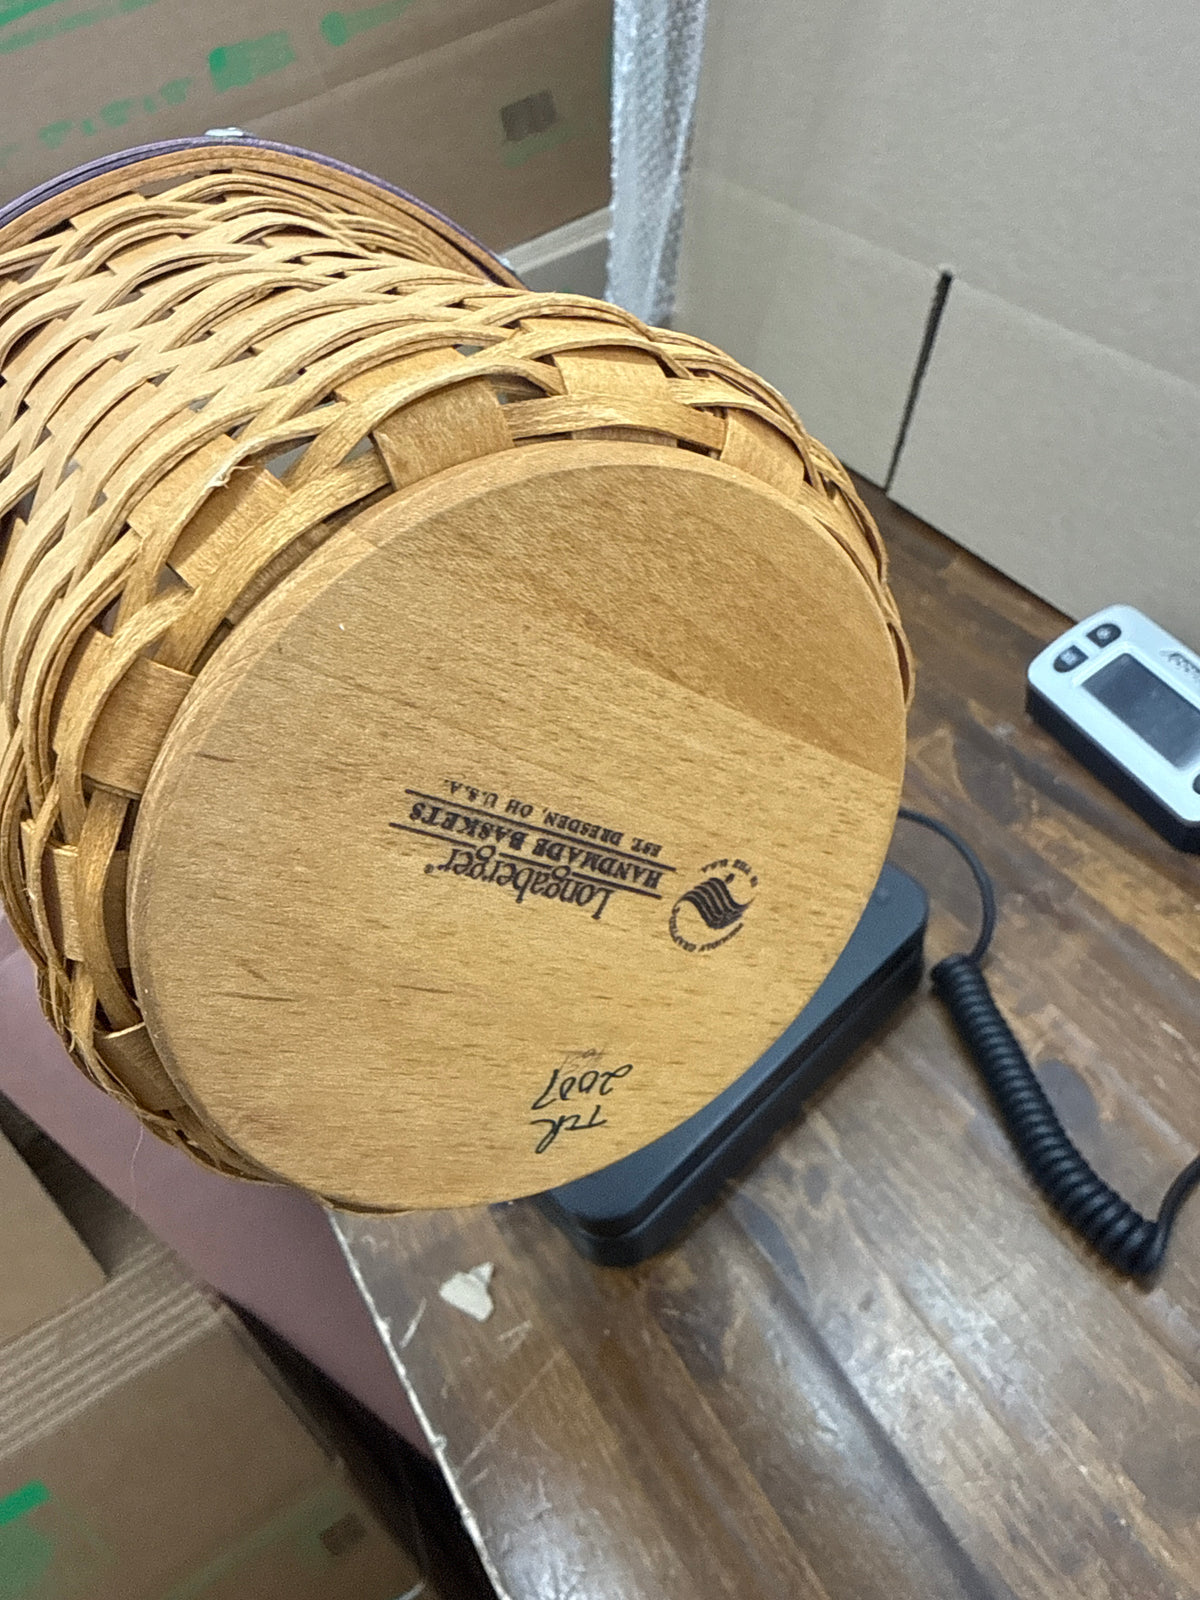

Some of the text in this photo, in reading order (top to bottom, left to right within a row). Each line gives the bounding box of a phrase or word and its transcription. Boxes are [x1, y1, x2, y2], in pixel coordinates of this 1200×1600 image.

[507, 799, 533, 818] OH
[543, 808, 624, 845] DRESDEN,
[409, 803, 663, 889] HANDMADE BASKETS
[632, 838, 662, 858] EST.
[531, 1064, 633, 1110] 2007
